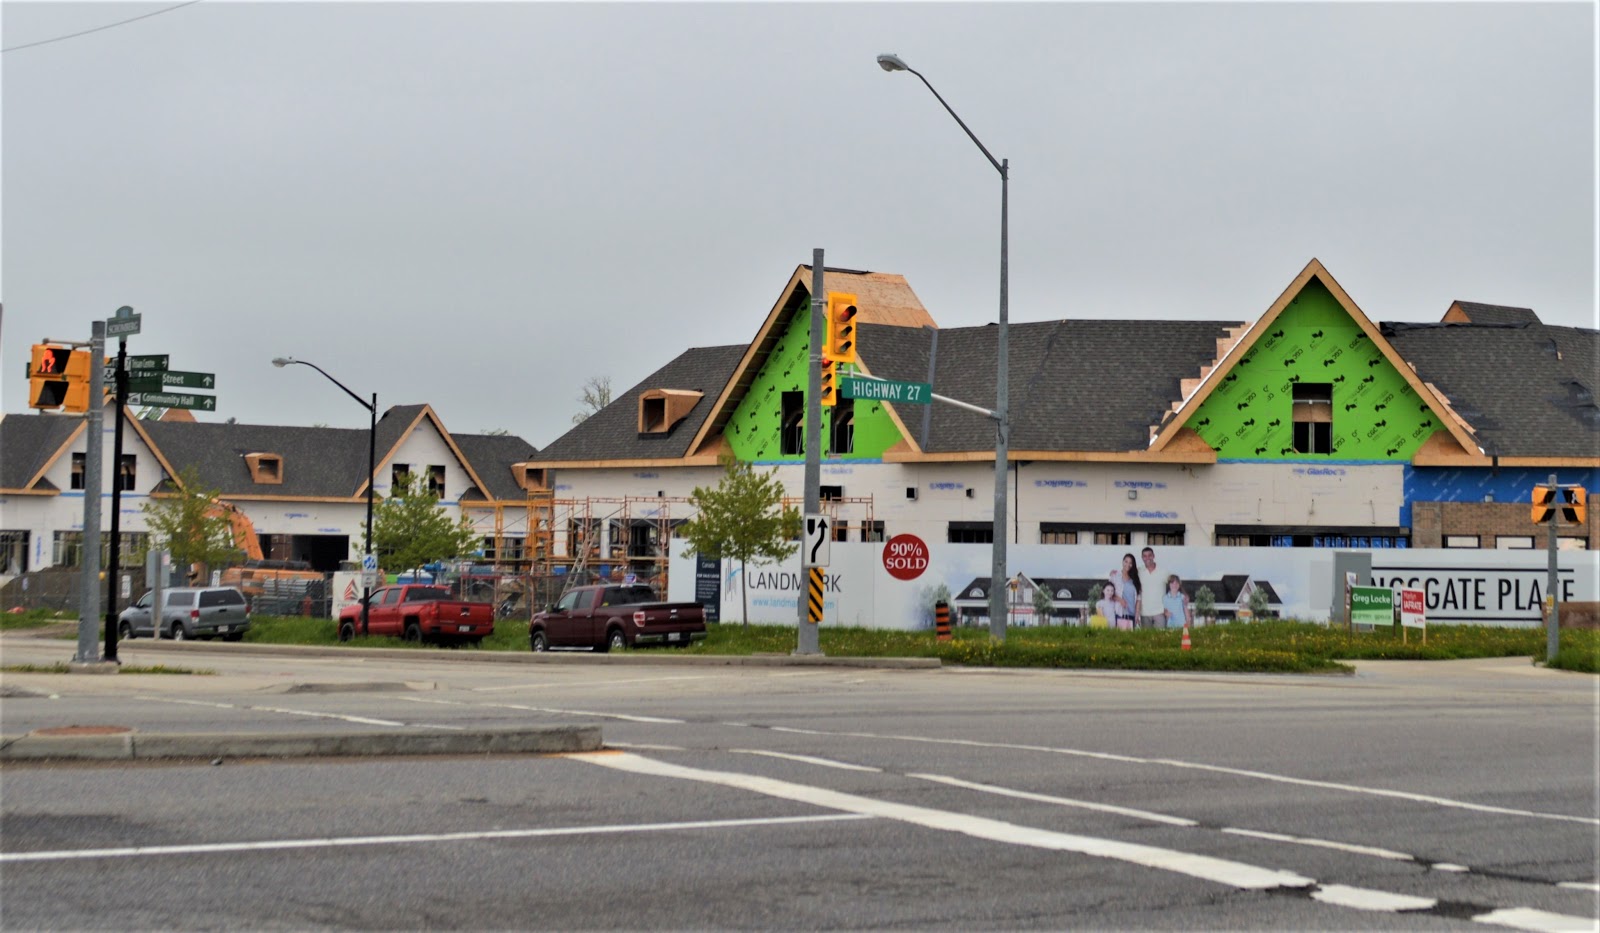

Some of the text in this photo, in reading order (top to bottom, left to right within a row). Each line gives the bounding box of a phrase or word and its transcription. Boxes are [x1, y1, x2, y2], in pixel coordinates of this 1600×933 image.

[162, 373, 184, 384] Street
[853, 382, 921, 400] HIGHWAY 27
[142, 393, 194, 406] Community Hall
[890, 542, 922, 557] 90%
[886, 558, 927, 569] SOLD
[748, 572, 842, 592] LANDMRK
[1352, 594, 1391, 605] Greg Locke
[1498, 578, 1574, 611] PLAE
[1404, 601, 1422, 611] IAFRATE
